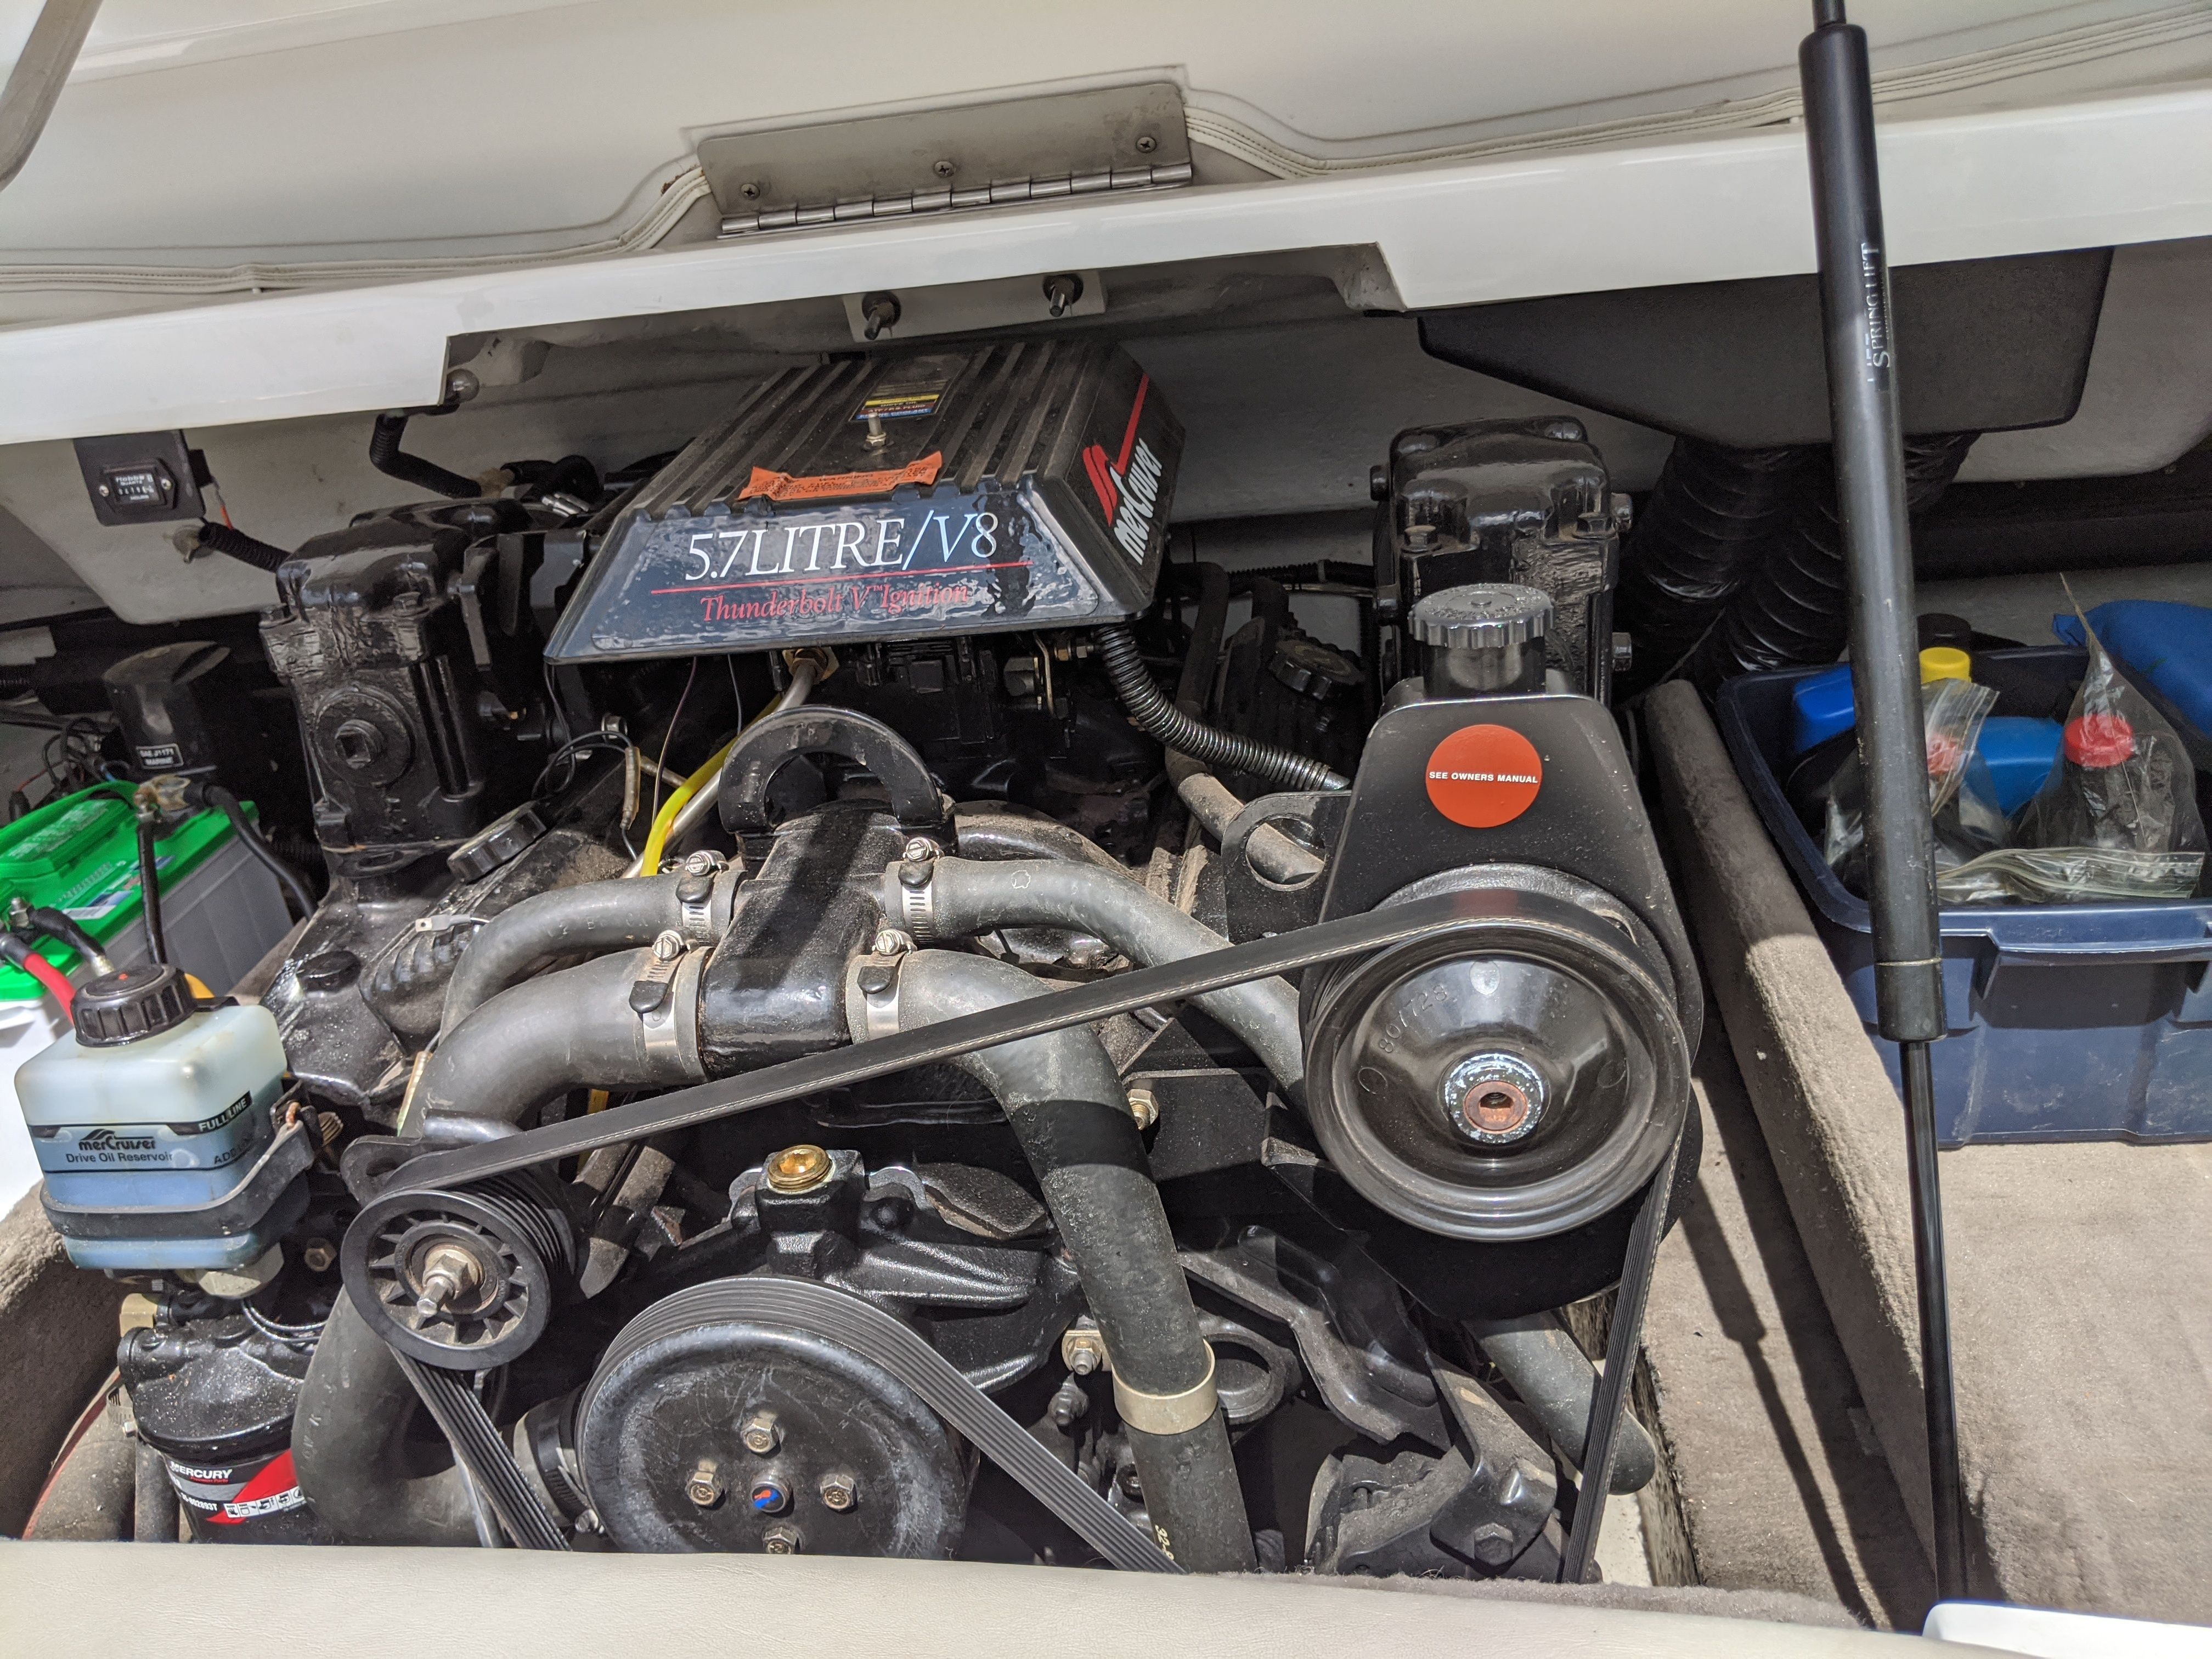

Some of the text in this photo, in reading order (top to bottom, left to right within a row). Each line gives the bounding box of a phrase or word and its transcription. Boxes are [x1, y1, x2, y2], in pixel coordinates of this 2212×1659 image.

[1866, 294, 1891, 368] SPRING
[700, 588, 843, 622] Thunderbolt
[881, 583, 968, 615] Ignition
[1429, 771, 1538, 783] SEE OWNERS MANUAL
[198, 1098, 248, 1133] FULL LINE
[66, 1151, 173, 1163] Drive Oil Reservoir
[170, 1460, 233, 1480] MERCURY
